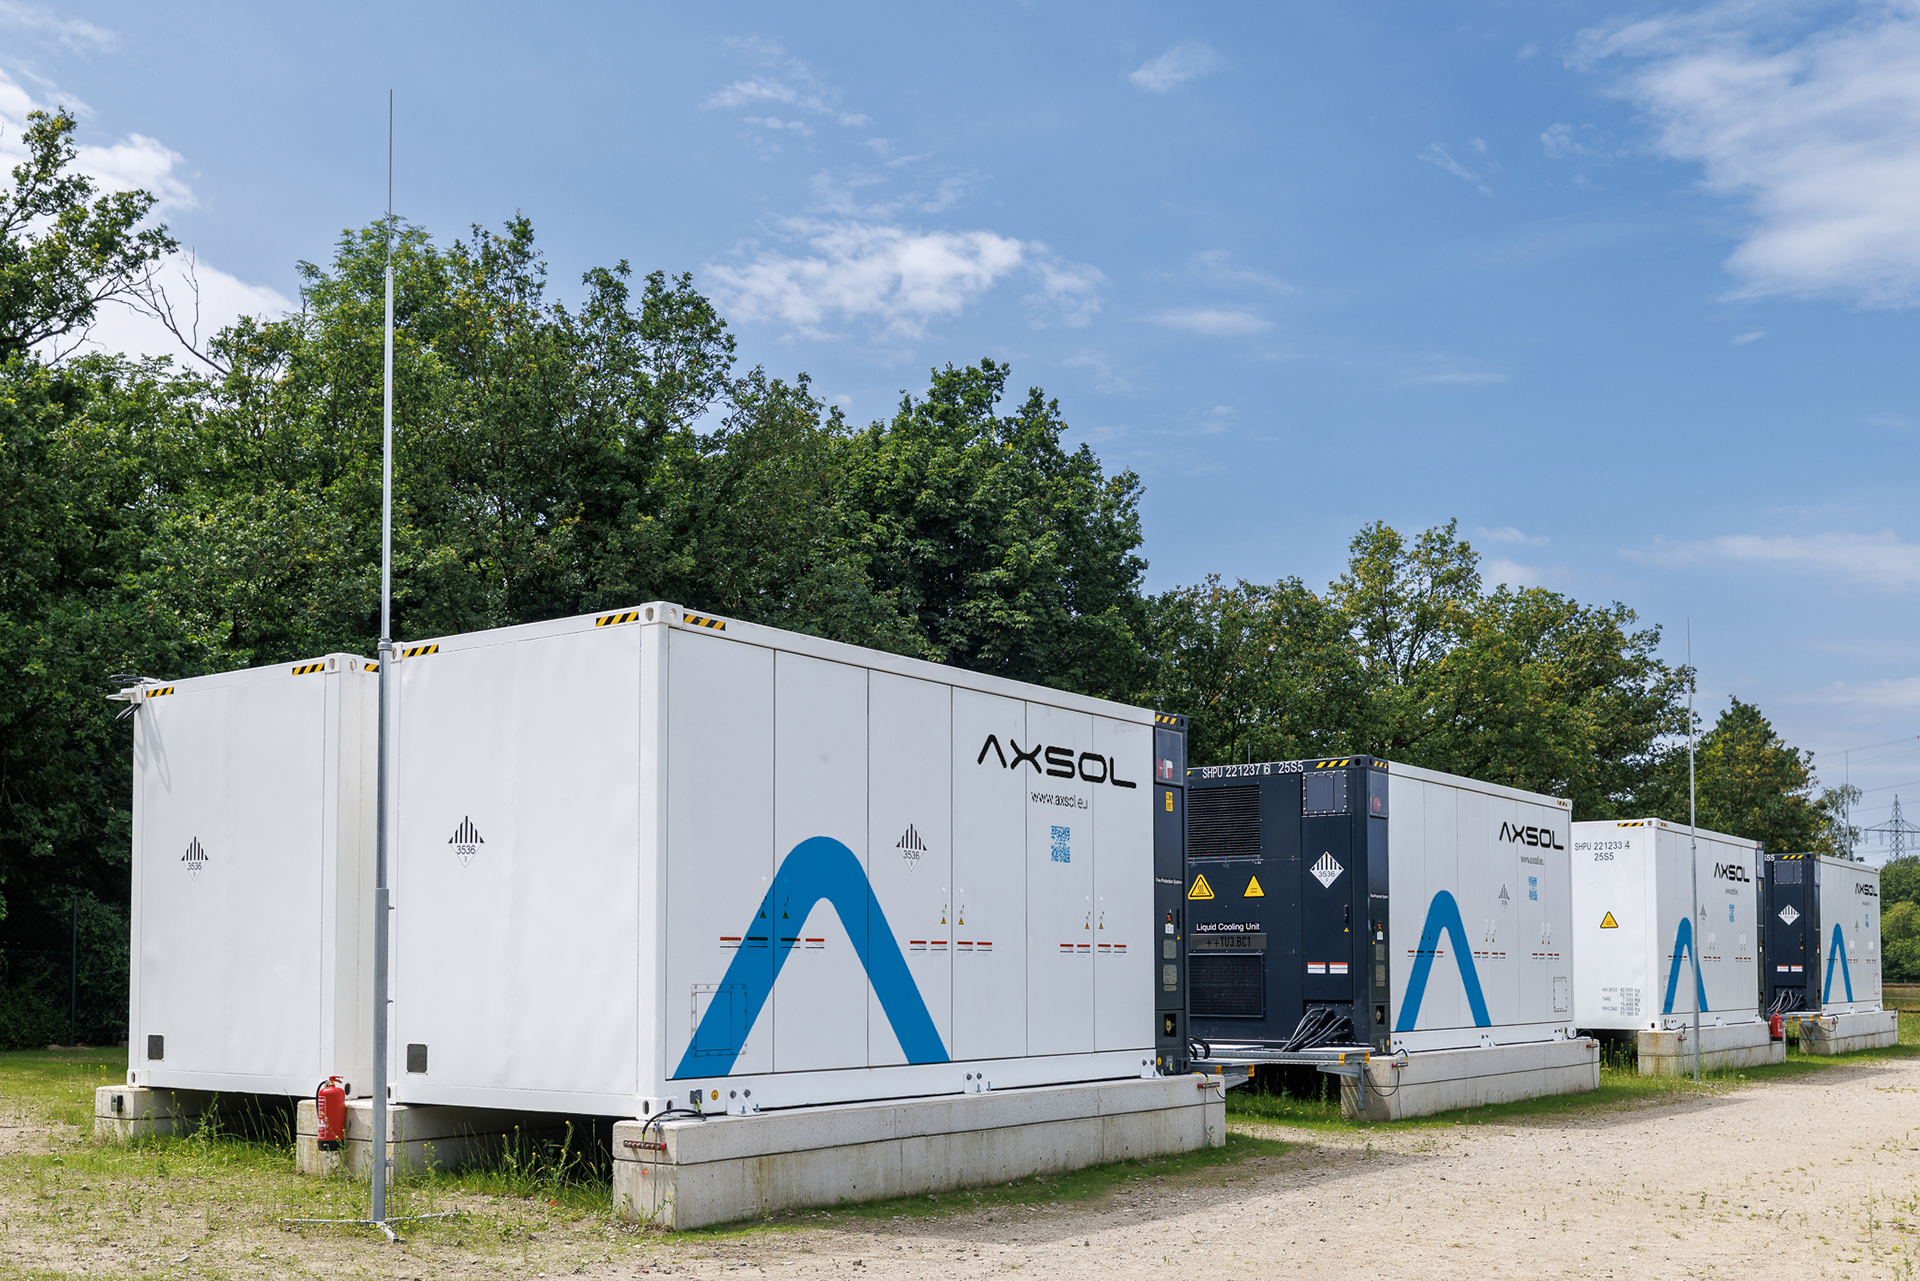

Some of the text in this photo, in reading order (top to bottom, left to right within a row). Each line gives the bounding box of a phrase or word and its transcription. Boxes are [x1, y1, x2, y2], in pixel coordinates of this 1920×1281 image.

[977, 734, 1137, 789] AXSOL
[1202, 761, 1304, 778] SHPU 221237 6 25S5
[1499, 821, 1564, 850] AXSOL
[456, 844, 476, 855] 3536
[1574, 842, 1591, 851] SHPU
[1593, 841, 1622, 850] 221233
[903, 849, 920, 860] 3536
[1594, 852, 1614, 861] 25S5
[187, 861, 202, 871] 3536
[1318, 870, 1336, 878] 3536
[1713, 862, 1750, 883] AXSOL
[1854, 882, 1878, 897] AXSOL
[1196, 922, 1260, 932] Liquid Cooling Unit
